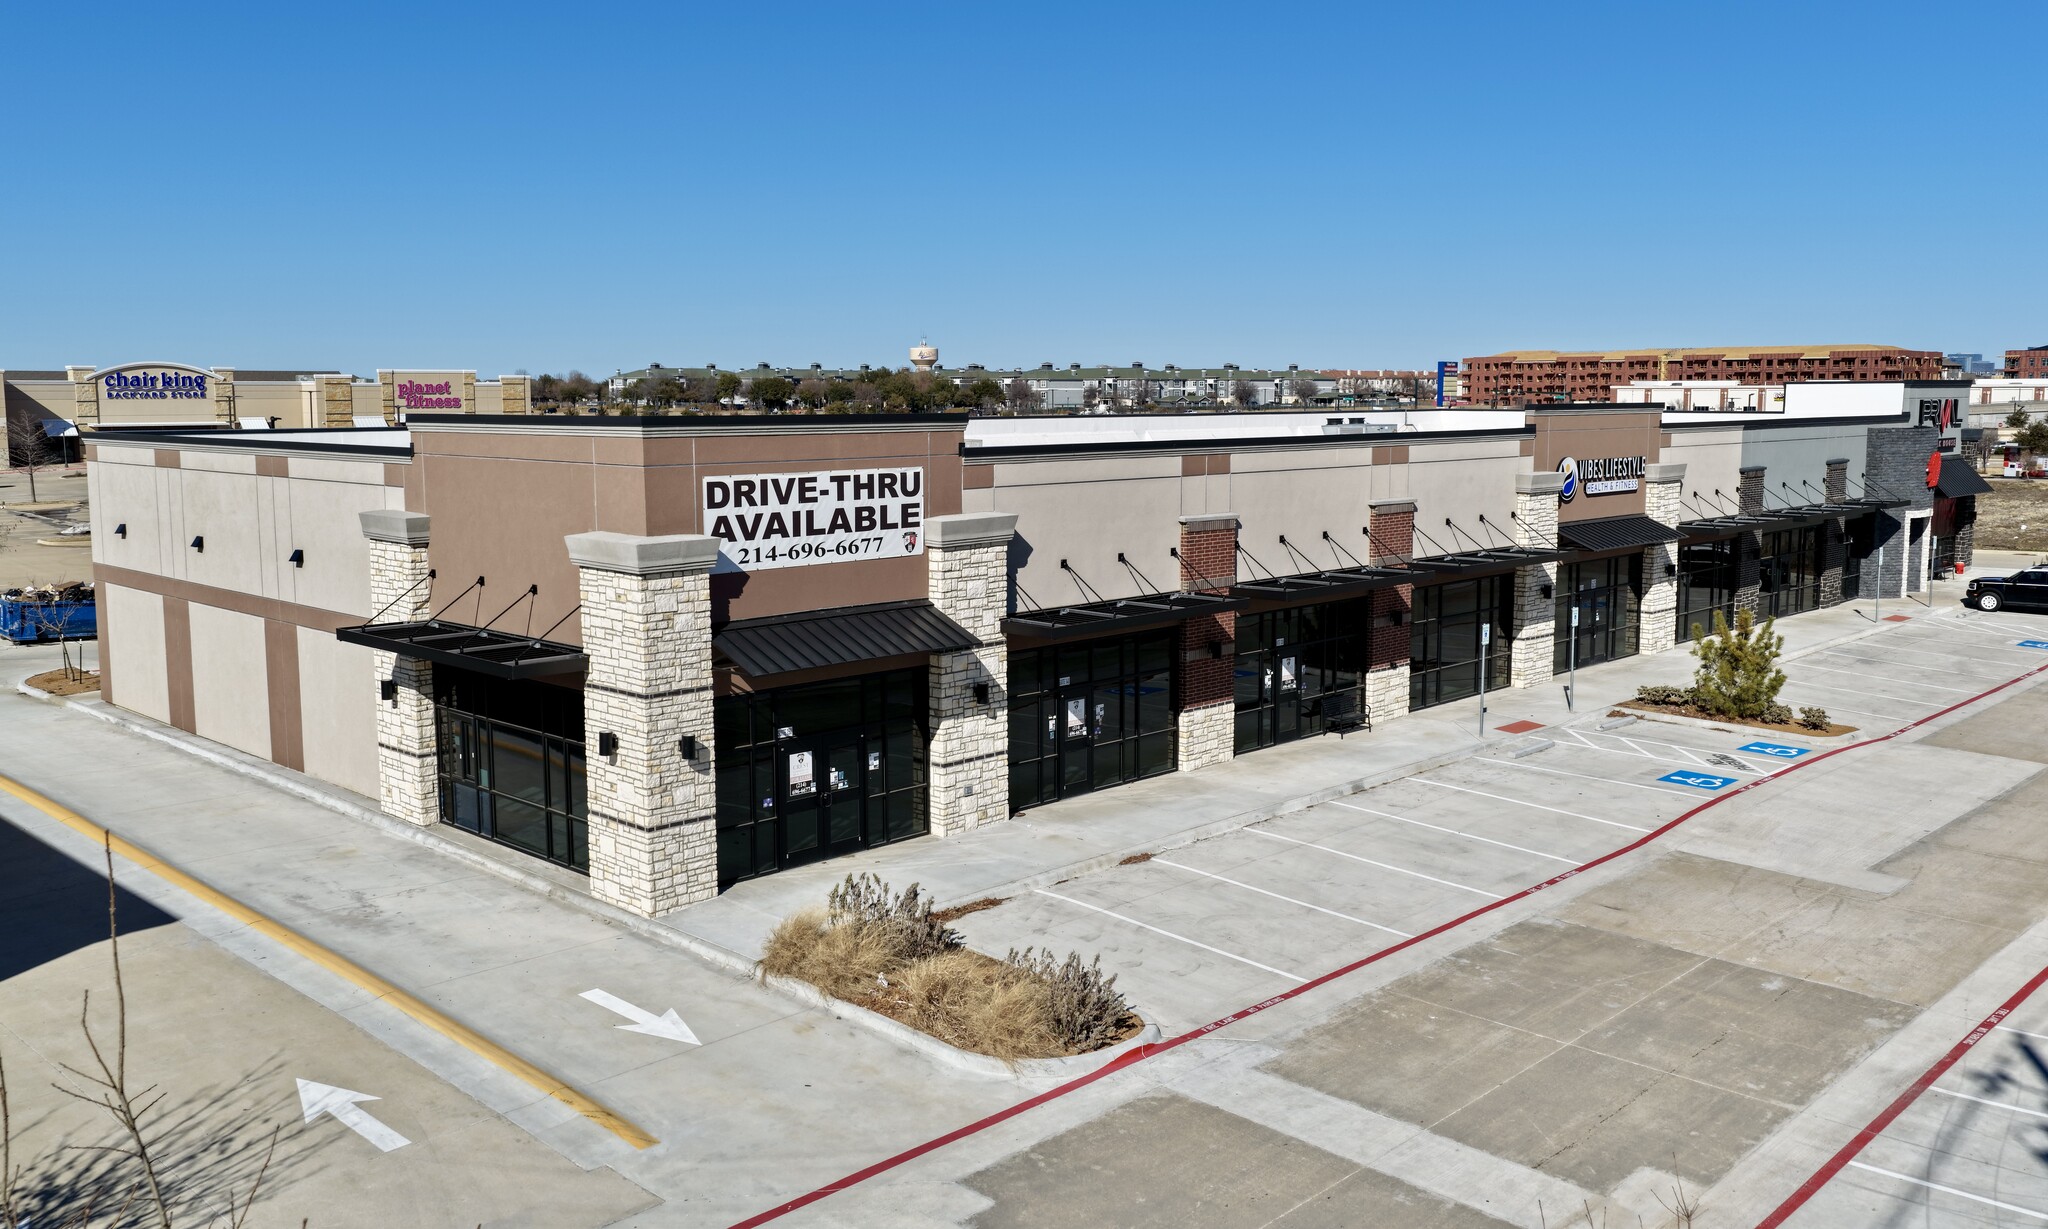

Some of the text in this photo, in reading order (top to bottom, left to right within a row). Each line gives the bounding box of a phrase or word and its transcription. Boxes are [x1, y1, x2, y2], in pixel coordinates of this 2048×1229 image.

[104, 371, 206, 390] chair king
[397, 380, 451, 399] planet
[107, 391, 206, 399] BACKYARD STORE
[405, 393, 461, 408] fitness
[1578, 456, 1646, 480] VIBES LIFESTYLE
[706, 471, 921, 509] DRIVE-THRU
[1587, 482, 1609, 492] HEALTH
[1615, 480, 1638, 489] FITNESS
[711, 502, 921, 543] AVAILABLE
[737, 536, 884, 565] 214-696-6677
